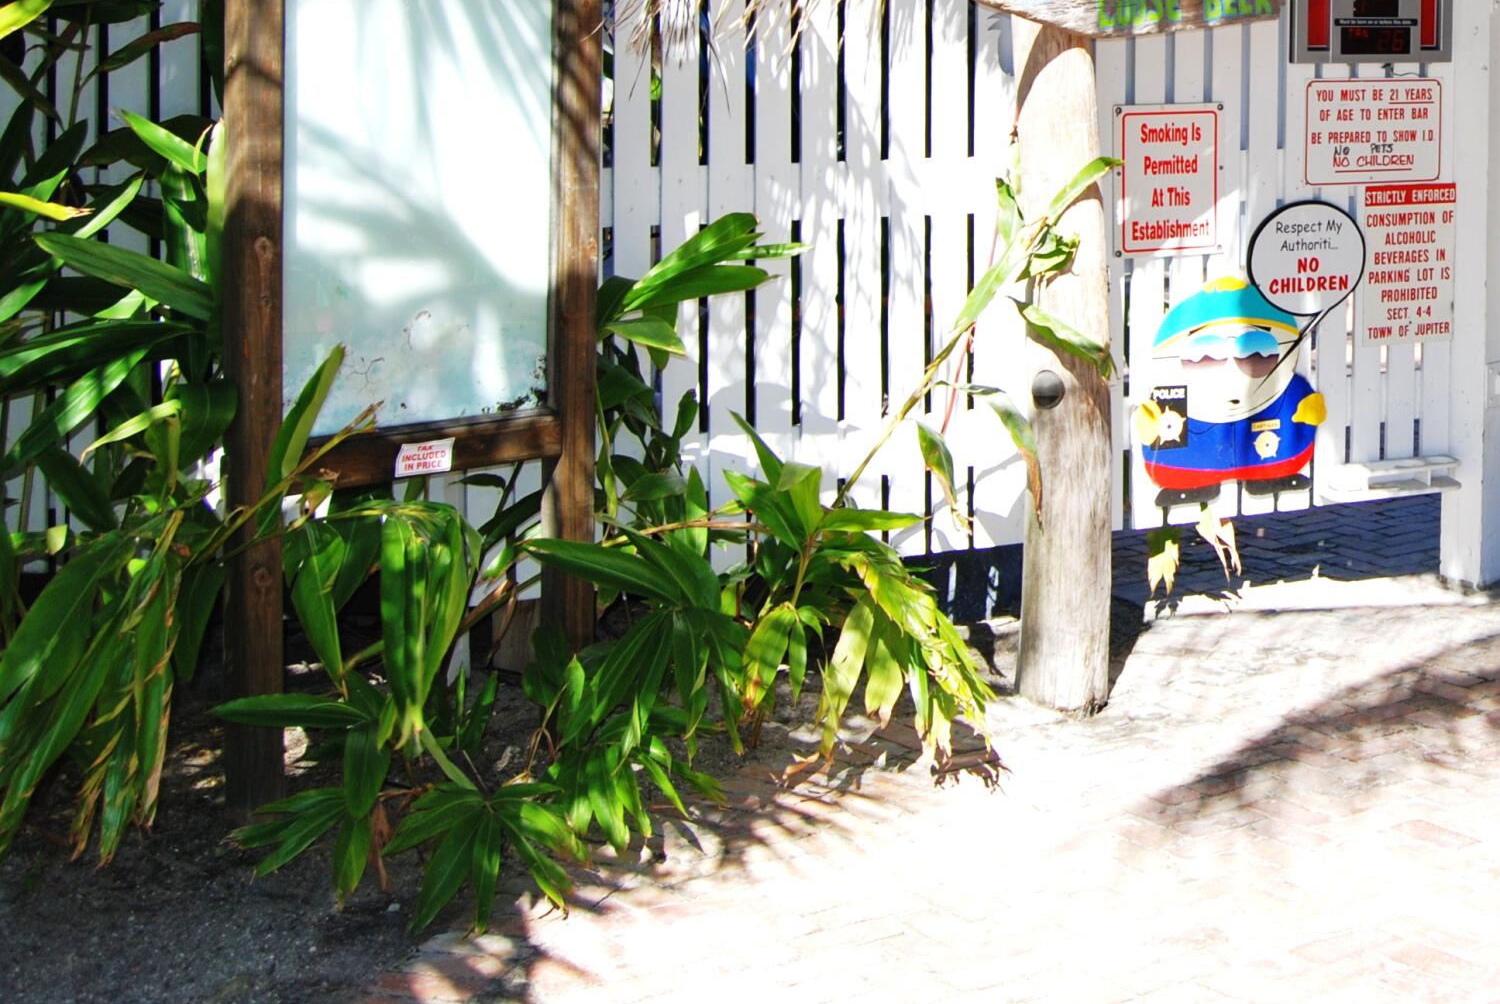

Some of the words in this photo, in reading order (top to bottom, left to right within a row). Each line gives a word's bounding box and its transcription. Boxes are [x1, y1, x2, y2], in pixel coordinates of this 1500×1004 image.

[1316, 90, 1334, 102] YOU
[1340, 90, 1366, 101] MUST
[1372, 89, 1384, 101] BE
[1389, 89, 1400, 101] 21
[1405, 88, 1433, 100] YEARS
[1320, 109, 1331, 121] OF
[1336, 109, 1354, 121] AGE
[1360, 109, 1372, 121] TO
[1377, 109, 1405, 120] ENTER
[1411, 108, 1429, 119] BAR
[1140, 123, 1189, 146] Smoking
[1191, 122, 1202, 142] Is
[1311, 132, 1322, 144] BE
[1328, 132, 1371, 144] PREPARED
[1377, 131, 1388, 143] TO
[1393, 130, 1417, 142] SHOW
[1334, 146, 1351, 156] NO
[1370, 143, 1394, 155] PETS
[1144, 154, 1198, 176] Permitted
[1332, 157, 1351, 167] NO
[1356, 155, 1415, 167] CHILDREN
[1151, 188, 1165, 208] At
[1167, 186, 1191, 207] This
[1365, 190, 1408, 204] STRICTLY
[1412, 187, 1456, 203] ENFORCED
[1366, 212, 1436, 228] CONSUMPTION
[1442, 210, 1455, 224] OF
[1131, 220, 1209, 242] Establishment
[1276, 221, 1322, 237] Respect
[1326, 219, 1343, 237] My
[1385, 230, 1437, 246] ALCOHOLIC
[1297, 257, 1319, 273] NO
[1374, 249, 1430, 265] BEVERAGES
[1436, 249, 1446, 262] IN
[1368, 270, 1410, 285] PARKING
[1417, 268, 1435, 282] LOT
[1441, 267, 1451, 280] IS
[1269, 275, 1348, 295] CHILDREN
[1381, 286, 1438, 303] PROHIBITED
[1416, 306, 1432, 318] 4-4
[1368, 326, 1393, 340] TOWN
[1399, 326, 1410, 338] OF
[1414, 321, 1450, 336] JUPITER
[402, 450, 446, 462] INCLUDED
[405, 462, 414, 471] IN
[417, 459, 442, 469] PRICE
